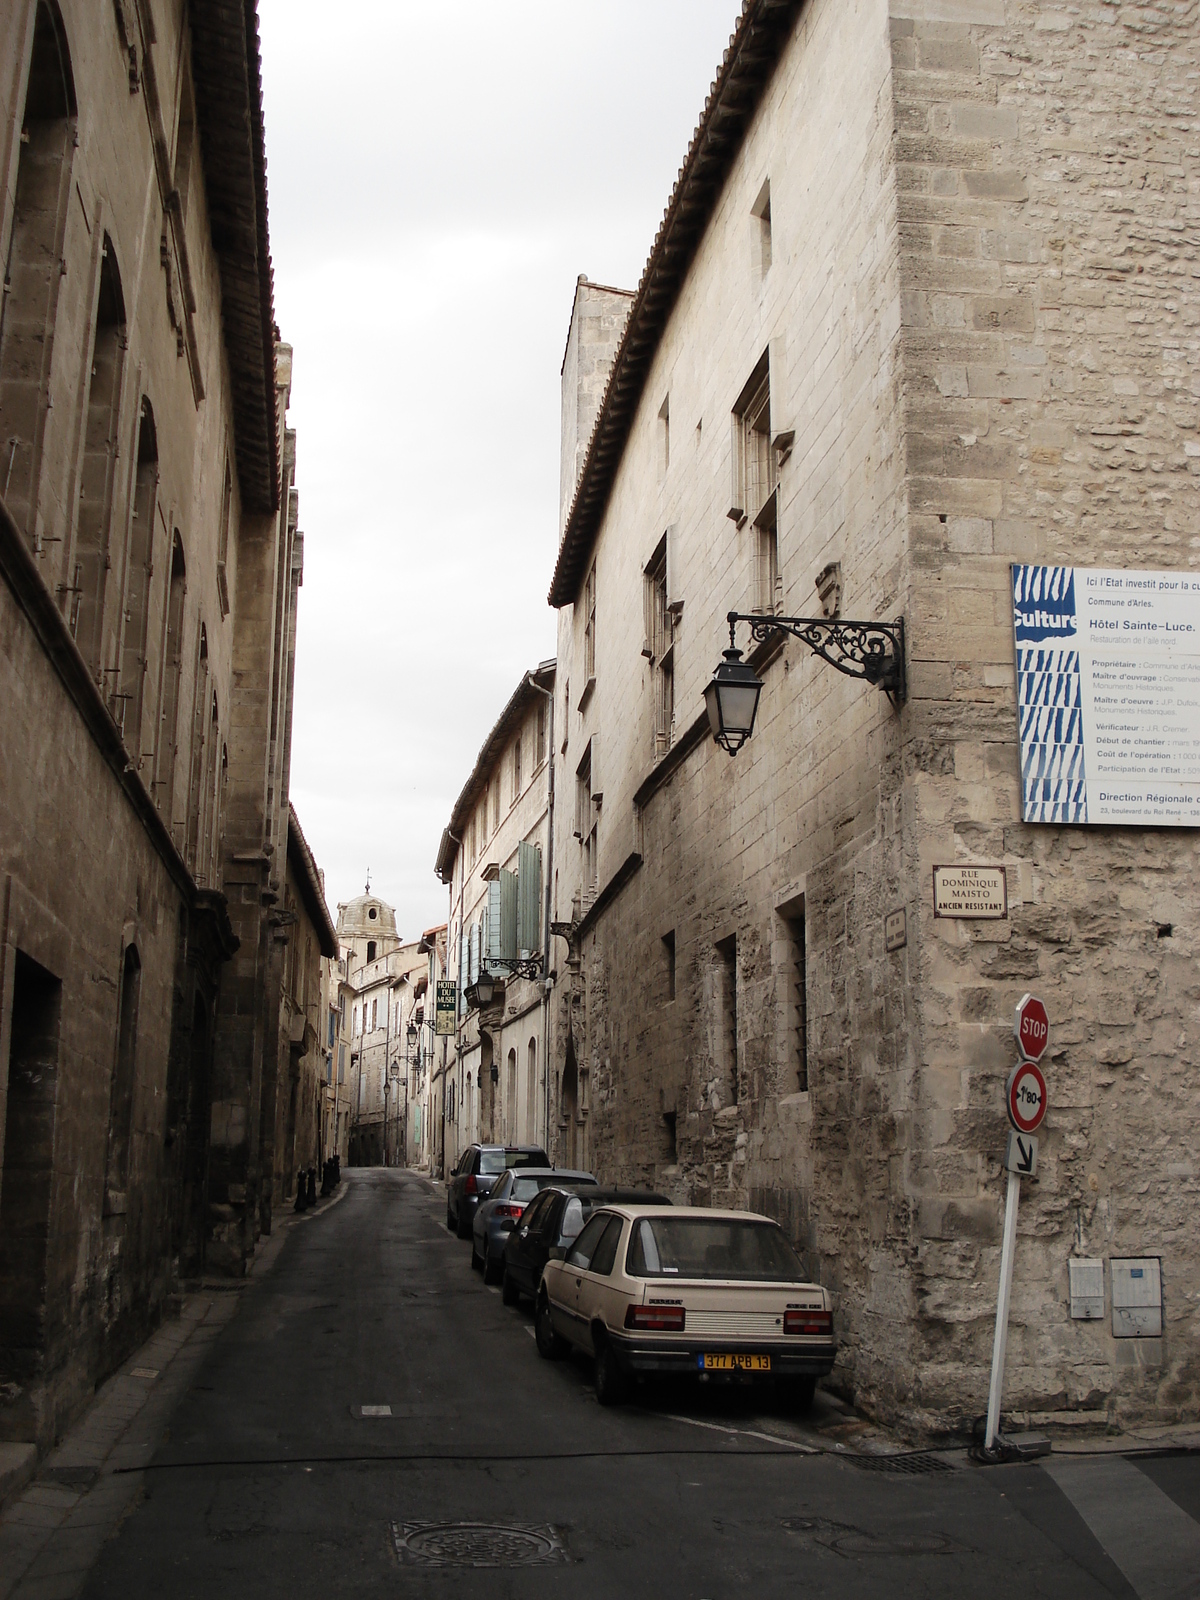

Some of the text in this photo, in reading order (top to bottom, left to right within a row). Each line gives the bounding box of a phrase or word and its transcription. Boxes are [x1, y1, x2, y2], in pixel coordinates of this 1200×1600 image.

[1086, 577, 1098, 586] Ici
[1100, 577, 1123, 587] l'Etat
[1125, 578, 1156, 589] investit
[1158, 581, 1179, 591] pour
[1181, 581, 1189, 590] la
[1087, 597, 1154, 608] Commune d'Arles.
[1014, 608, 1077, 628] Culture
[1089, 619, 1119, 630] Hôtel
[1090, 635, 1131, 645] Restauration
[1132, 636, 1142, 645] de
[1091, 659, 1137, 669] Propriétaire
[1119, 673, 1157, 682] d'ouvrage
[1092, 682, 1134, 691] Monuments
[1120, 697, 1154, 705] d'oeuvre
[1093, 706, 1135, 714] Monuments
[1095, 723, 1139, 732] Vérificateur
[1096, 737, 1119, 745] Début
[1121, 737, 1132, 745] de
[1133, 738, 1165, 746] chantier
[1097, 750, 1116, 758] Coût
[1130, 752, 1171, 760] l'opération
[1097, 765, 1147, 774] Participation
[1149, 766, 1159, 774] de
[1099, 793, 1193, 804] Direction Régionale
[1165, 808, 1181, 816] René
[961, 870, 979, 878] RUE
[942, 879, 999, 888] DOMINIQUE
[952, 890, 990, 898] MAISTO
[938, 902, 963, 910] ANCIEN
[1022, 1016, 1047, 1039] STOP
[706, 1354, 726, 1367] 377
[757, 1356, 769, 1368] 13
